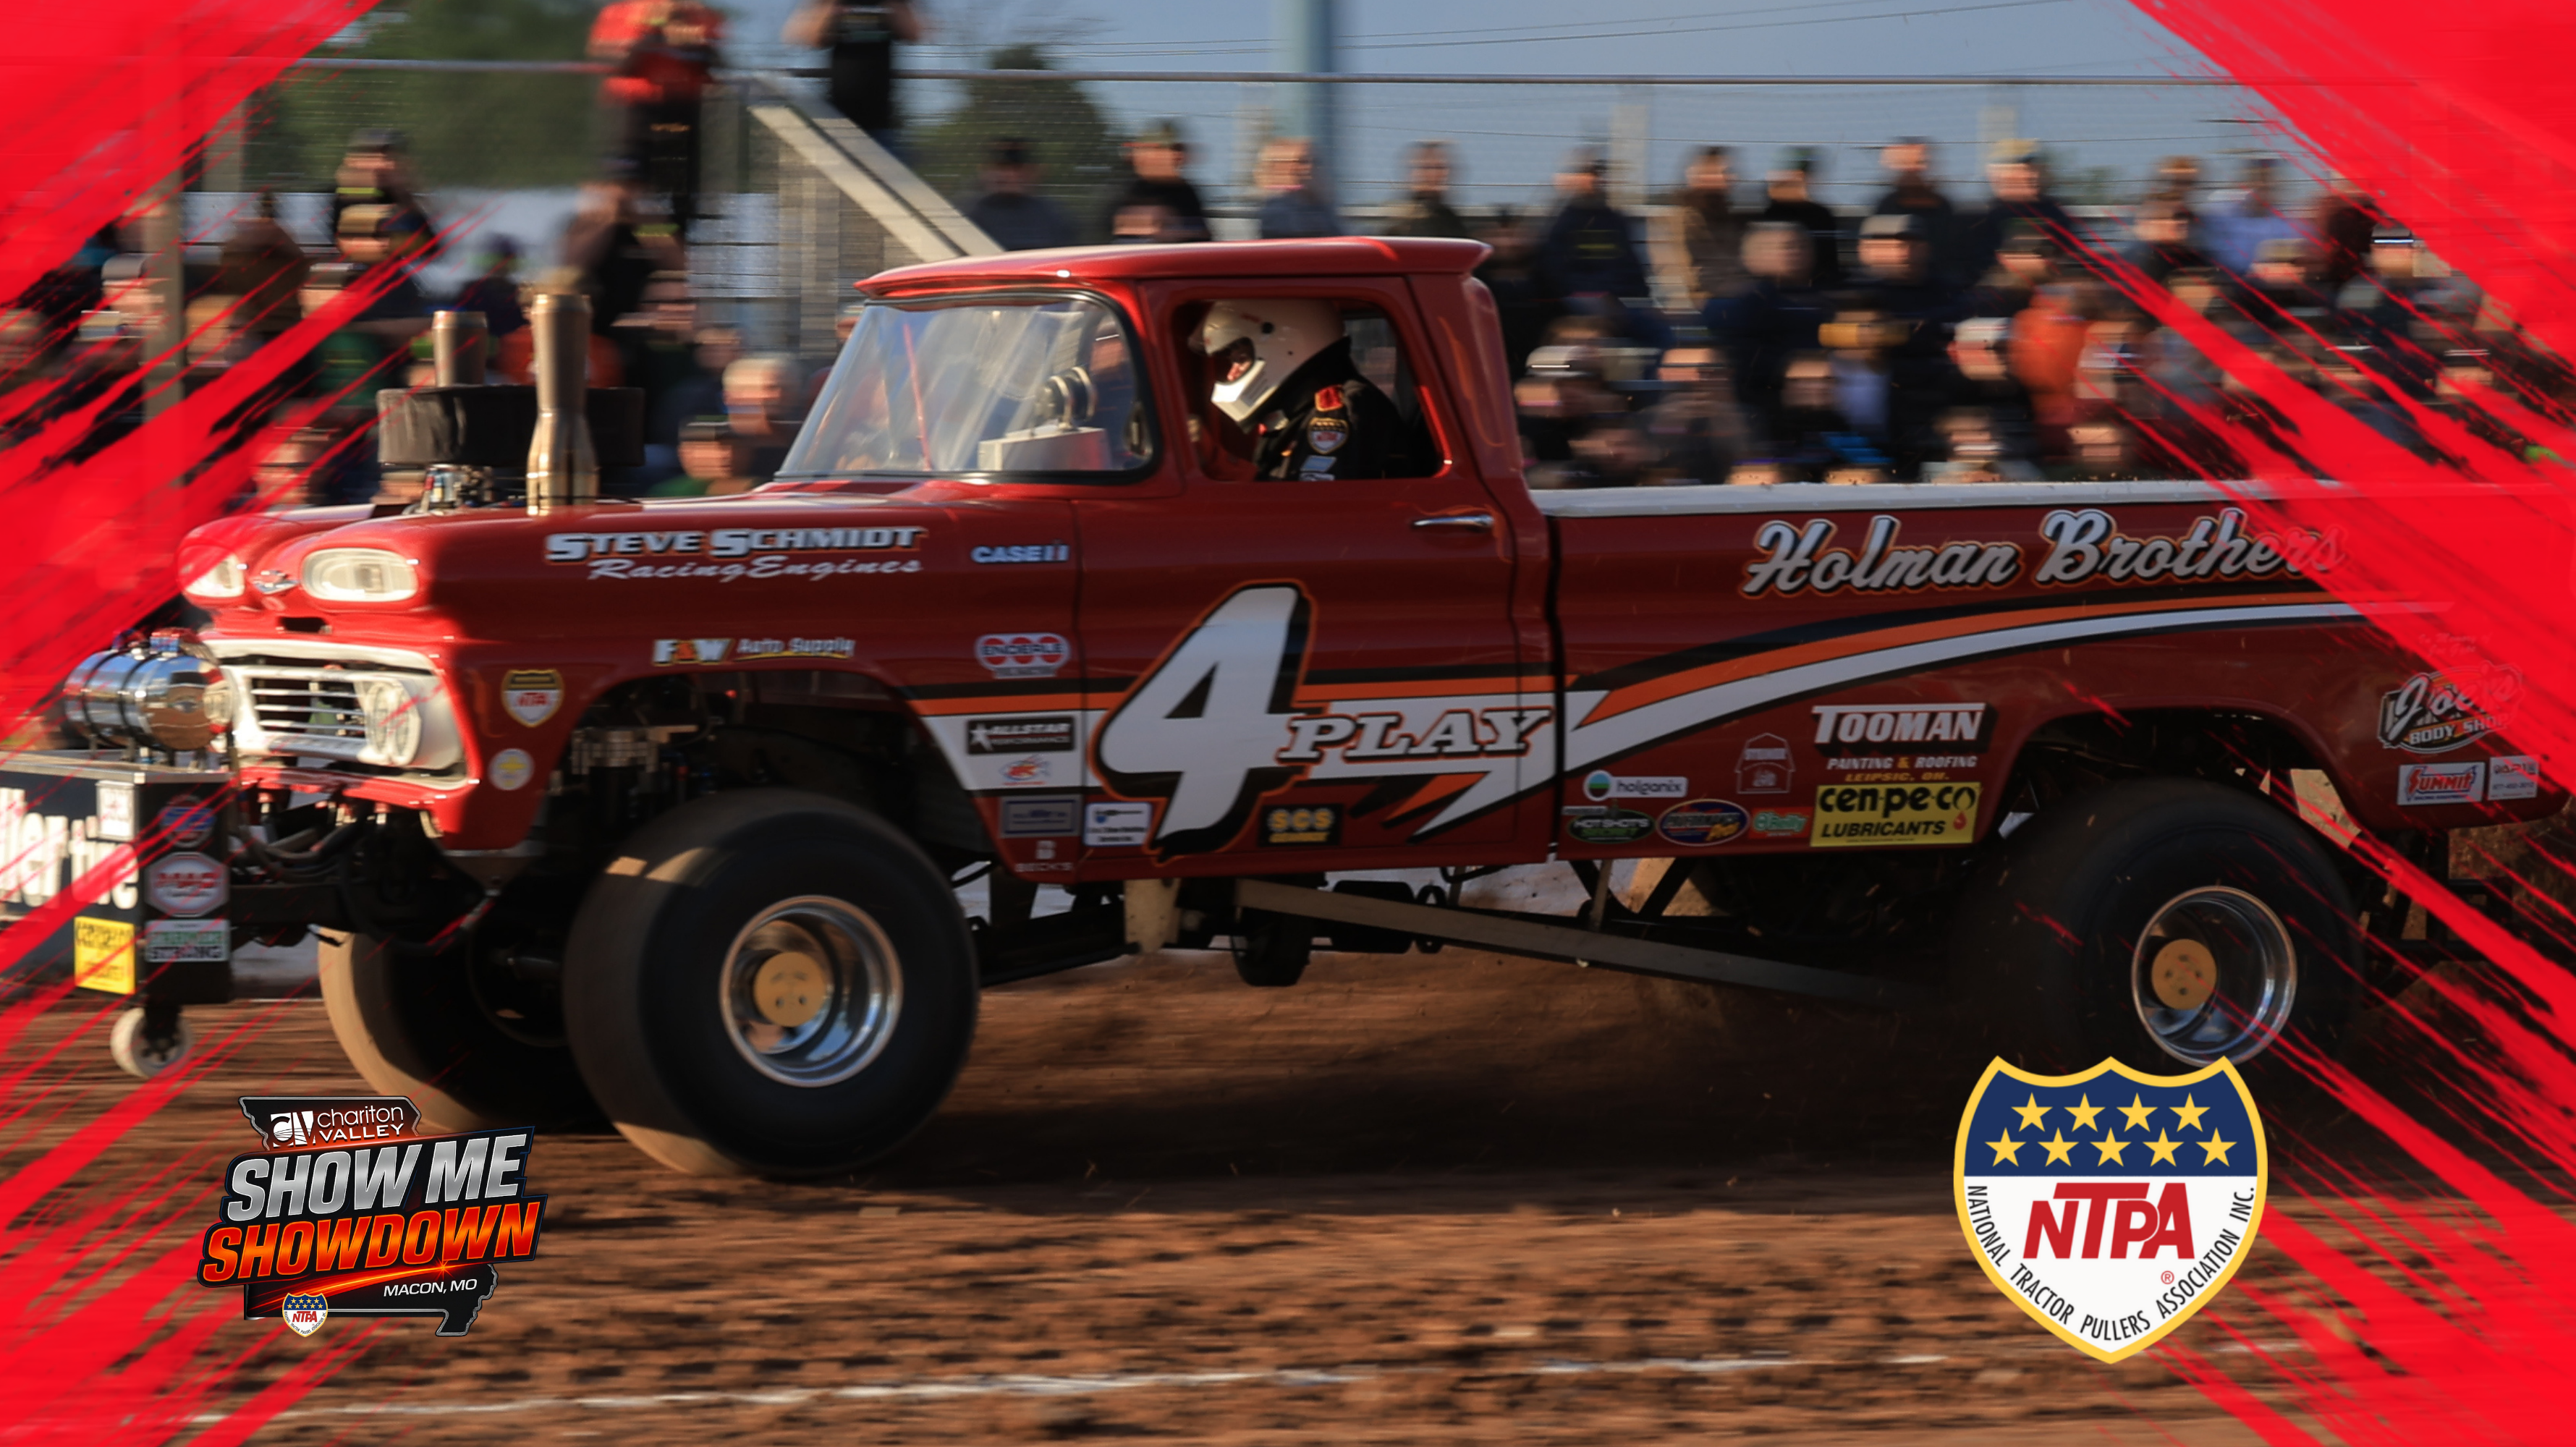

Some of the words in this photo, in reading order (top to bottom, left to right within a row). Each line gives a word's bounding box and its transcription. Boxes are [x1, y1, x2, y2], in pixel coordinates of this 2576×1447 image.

[545, 530, 705, 562] STEVE
[708, 527, 928, 560] SCHMIDT
[1742, 514, 2022, 596] Holman
[2035, 507, 2346, 583] Brothers
[737, 638, 784, 654] Auto
[789, 637, 855, 657] Supply
[1094, 582, 1308, 855] 4
[1275, 708, 1556, 763] PLAY
[1811, 702, 1986, 744] TOOMAN
[2410, 725, 2456, 745] BODY
[1826, 758, 1894, 770] PAINTING
[1897, 757, 1910, 769] &
[1914, 756, 1978, 768] ROOFING
[1616, 779, 1682, 795] holganix
[1268, 808, 1334, 832] SCS
[1821, 820, 1946, 839] LUBRICANTS
